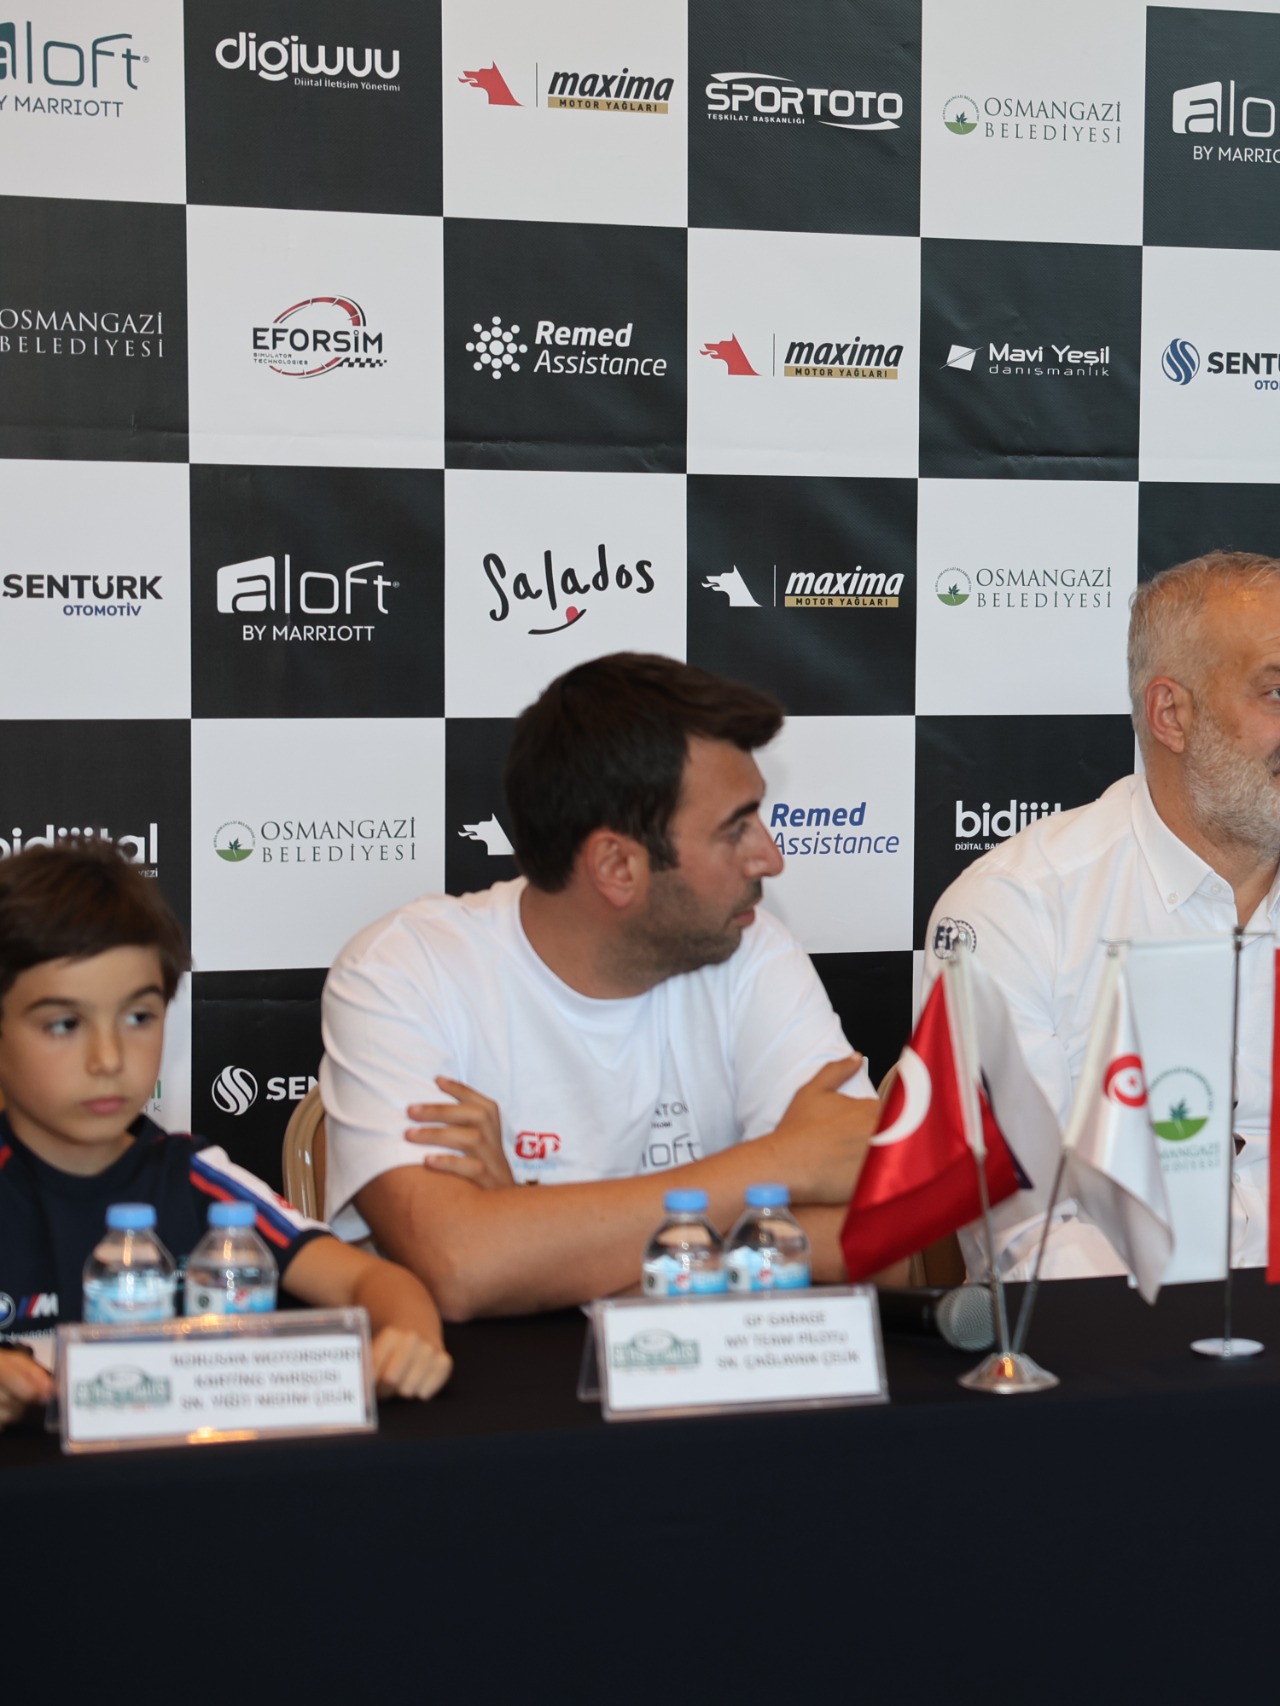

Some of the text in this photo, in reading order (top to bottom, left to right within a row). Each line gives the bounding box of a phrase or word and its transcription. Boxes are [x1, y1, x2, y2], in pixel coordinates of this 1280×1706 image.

[216, 32, 399, 82] digiwuu
[361, 82, 400, 91] Yönetimi
[548, 68, 674, 103] maxima
[15, 96, 123, 117] MARRIOTT
[558, 98, 659, 113] MOTOR YAĞLARI
[985, 98, 1120, 122] OSMANGAZİ
[986, 121, 1120, 143] BELEDİYESİ
[1194, 146, 1213, 160] BY
[0, 309, 162, 334] OSMANGAZİ
[535, 321, 633, 347] Remed
[0, 336, 162, 357] BELEDİYESİ
[785, 336, 903, 369] maxima
[990, 343, 1109, 366] Mavi Yeşil
[534, 350, 666, 376] Assistance
[794, 366, 888, 379] MOTOR YAĞLARI
[217, 554, 391, 614] aloft
[482, 543, 655, 622] Salados
[785, 566, 904, 595] maxima
[977, 567, 1110, 587] OSMANGAZİ
[63, 603, 141, 616] OTOMOTİV
[795, 595, 889, 607] MOTOR YAĞLARI
[978, 591, 1110, 607] BELEDİYESİ
[243, 625, 375, 641] BY MARRIOTT
[770, 802, 866, 827] Remed
[261, 817, 414, 840] OSMANGAZİ
[263, 843, 415, 862] BELEDİYESİ
[773, 831, 900, 856] Assistance
